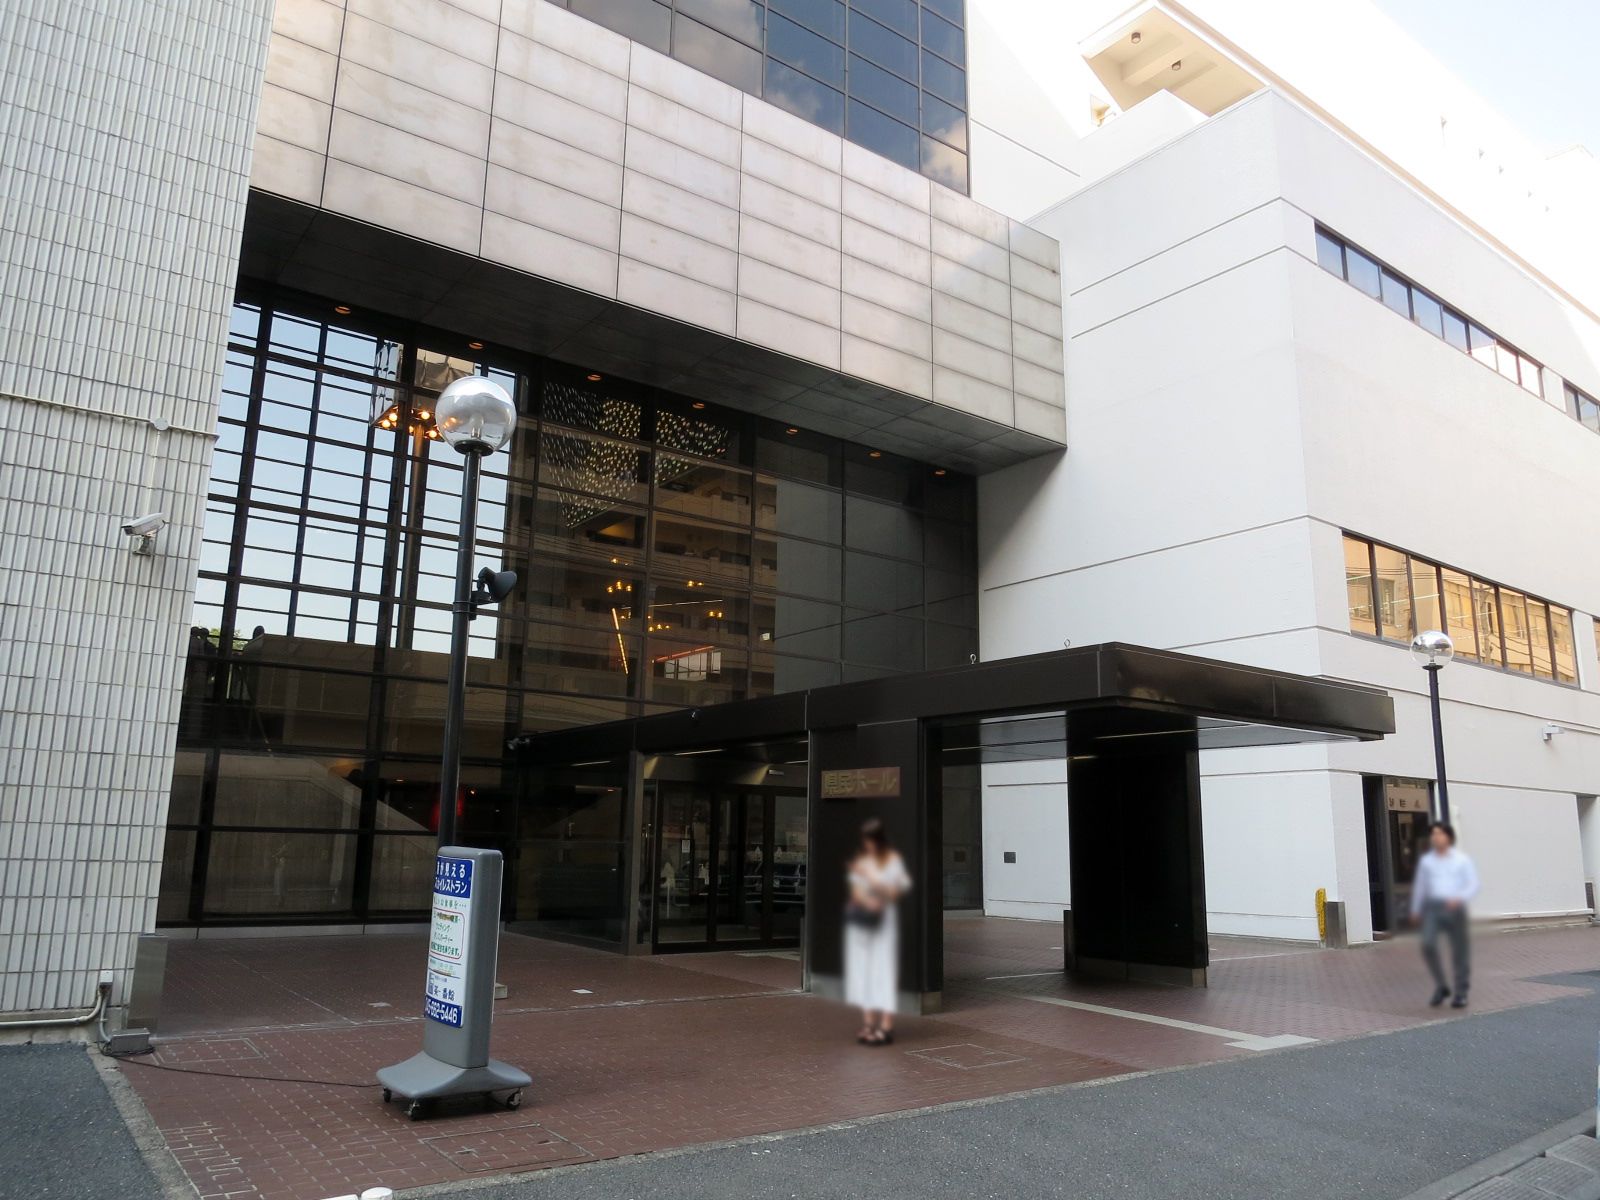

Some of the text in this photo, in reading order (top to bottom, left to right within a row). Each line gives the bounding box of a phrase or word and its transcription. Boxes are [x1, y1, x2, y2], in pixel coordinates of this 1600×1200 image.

[823, 770, 897, 797] 県民ホール
[434, 876, 468, 894] スカイレストラン
